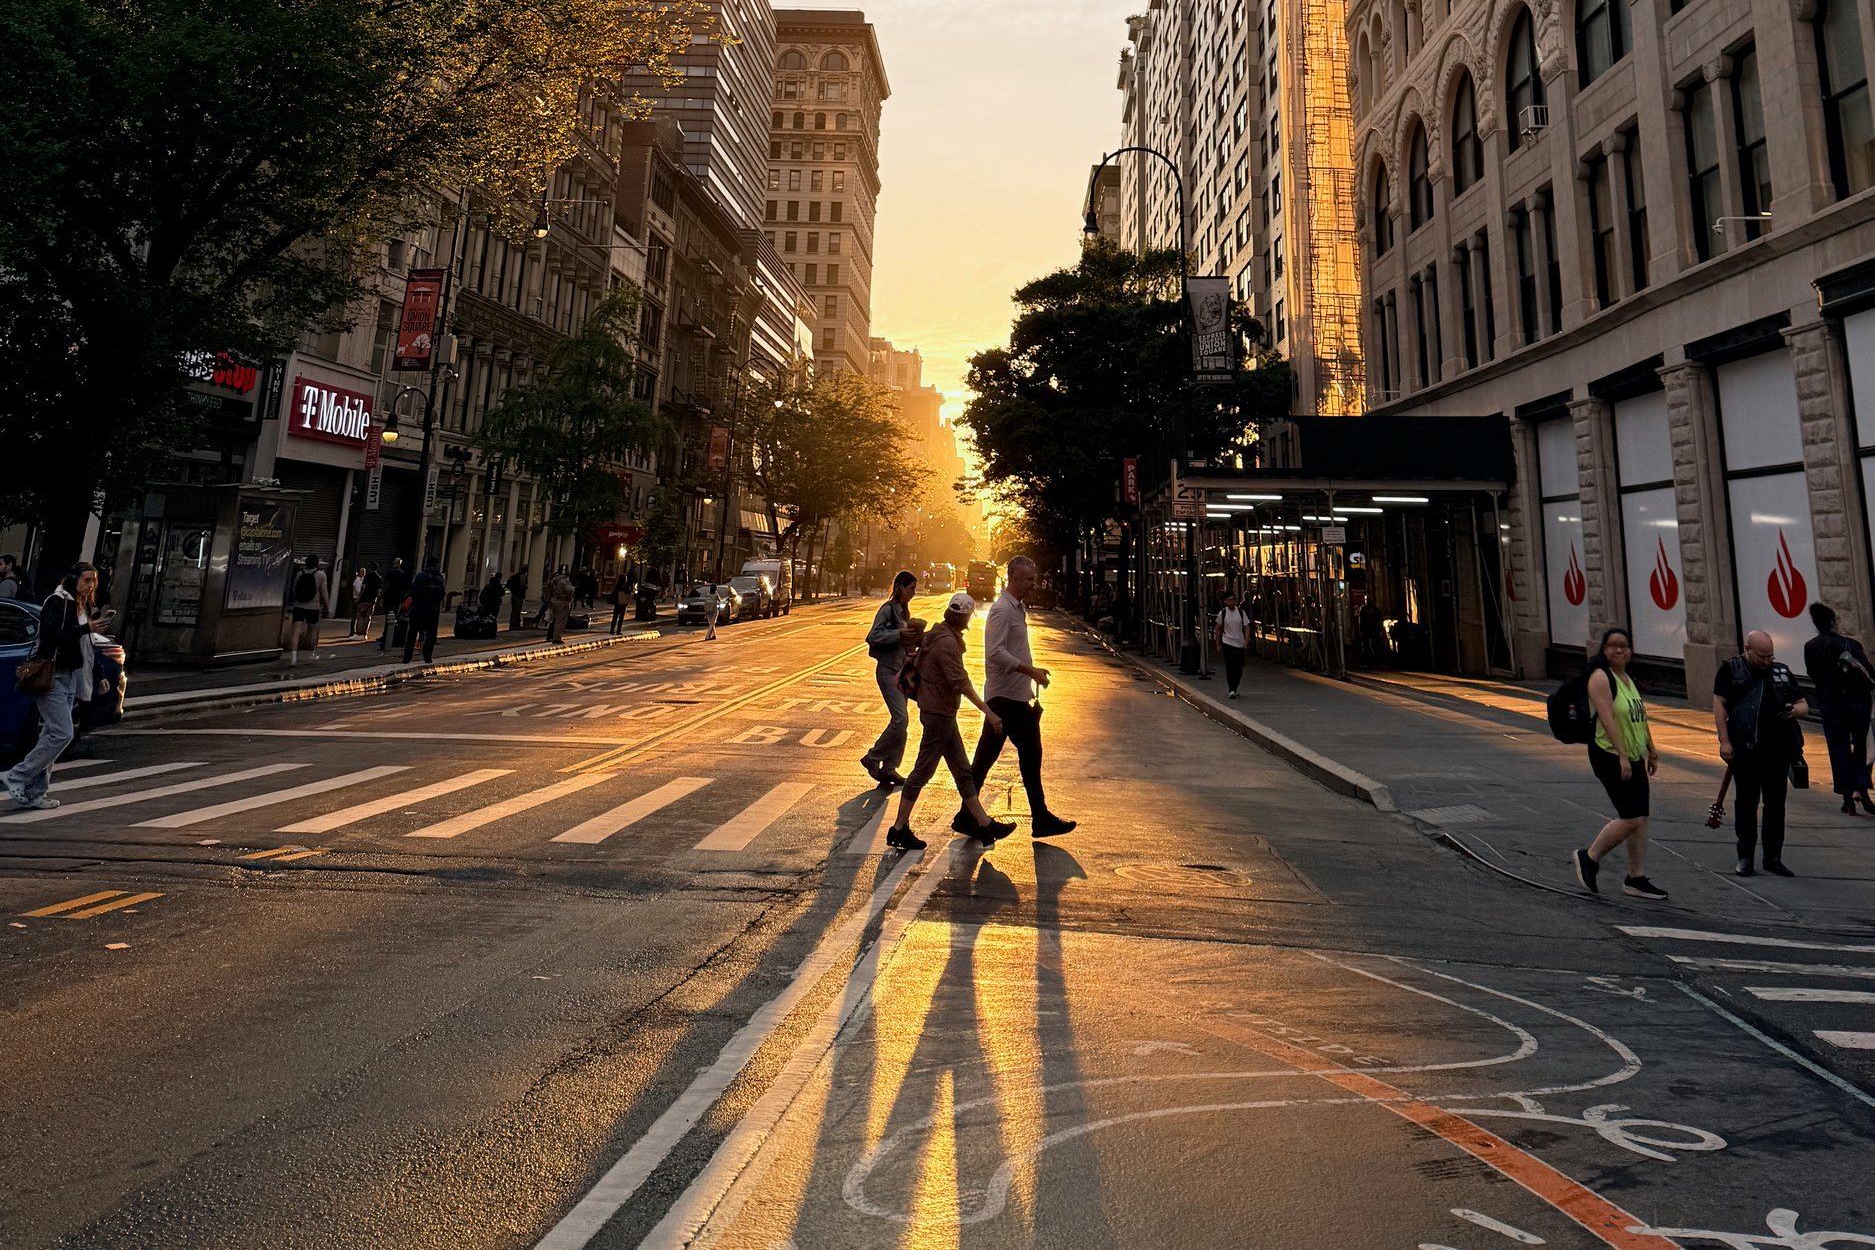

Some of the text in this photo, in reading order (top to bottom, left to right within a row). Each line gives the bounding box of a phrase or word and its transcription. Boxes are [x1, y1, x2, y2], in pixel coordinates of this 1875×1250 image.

[407, 310, 431, 322] UNION
[402, 321, 433, 333] SQUARE
[1199, 339, 1227, 351] UNION
[1199, 346, 1227, 356] SQUARE
[1127, 464, 1136, 494] PARK
[368, 476, 380, 503] LUSH
[426, 483, 436, 508] LUSH
[242, 511, 260, 526] Target
[535, 681, 745, 695] TRUCK
[459, 703, 678, 720] ONLY
[1626, 698, 1645, 723] LOV
[721, 725, 856, 748] BU
